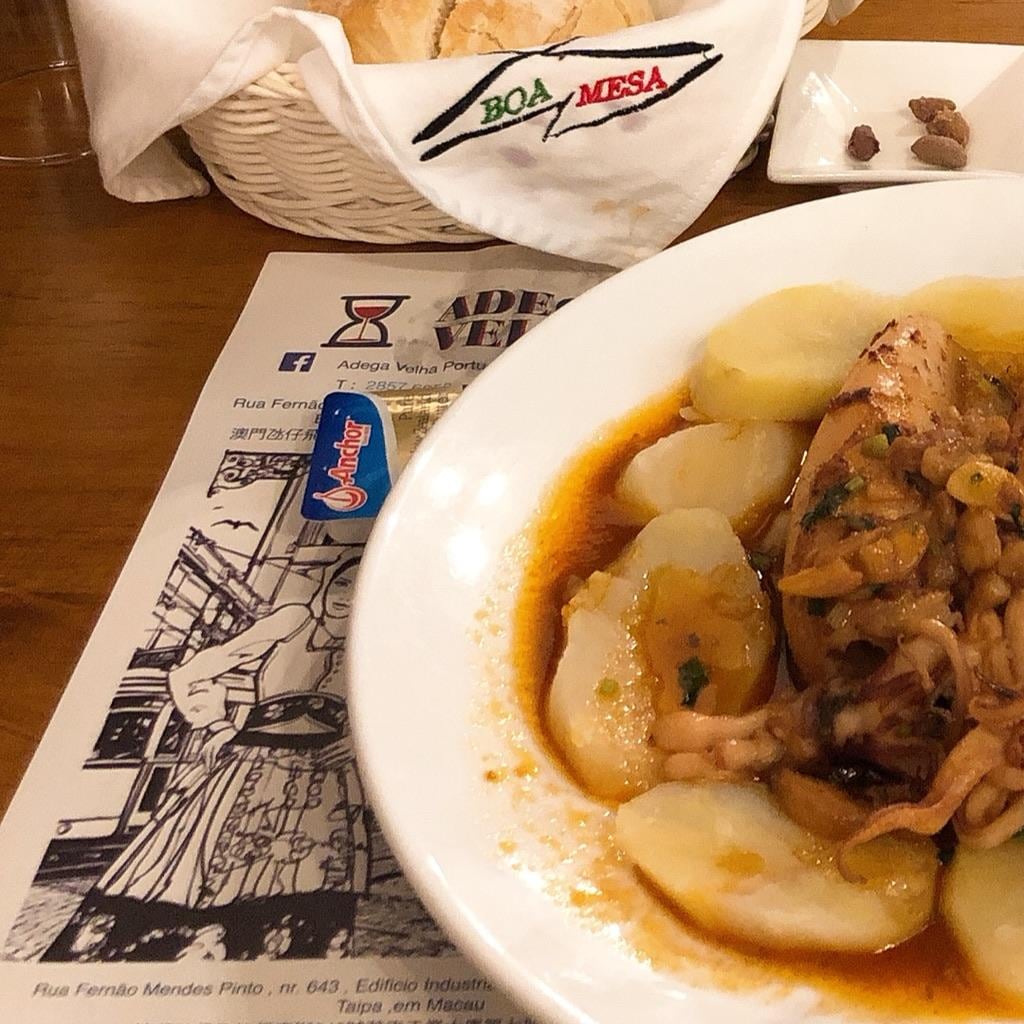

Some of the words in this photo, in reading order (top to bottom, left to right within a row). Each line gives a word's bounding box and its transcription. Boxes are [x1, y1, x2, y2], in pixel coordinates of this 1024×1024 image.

[480, 78, 554, 125] BOA
[575, 66, 669, 108] MESA
[435, 289, 576, 322] ADE
[337, 359, 390, 372] Adega
[396, 362, 438, 375] Velha
[233, 398, 266, 409] Rua
[329, 420, 364, 485] Anchor
[33, 982, 69, 996] Rua
[75, 982, 138, 997] Fernão
[143, 982, 213, 996] Mendes
[219, 981, 264, 995] Pinto
[337, 999, 383, 1014] Taipa
[426, 999, 486, 1012] Macau
